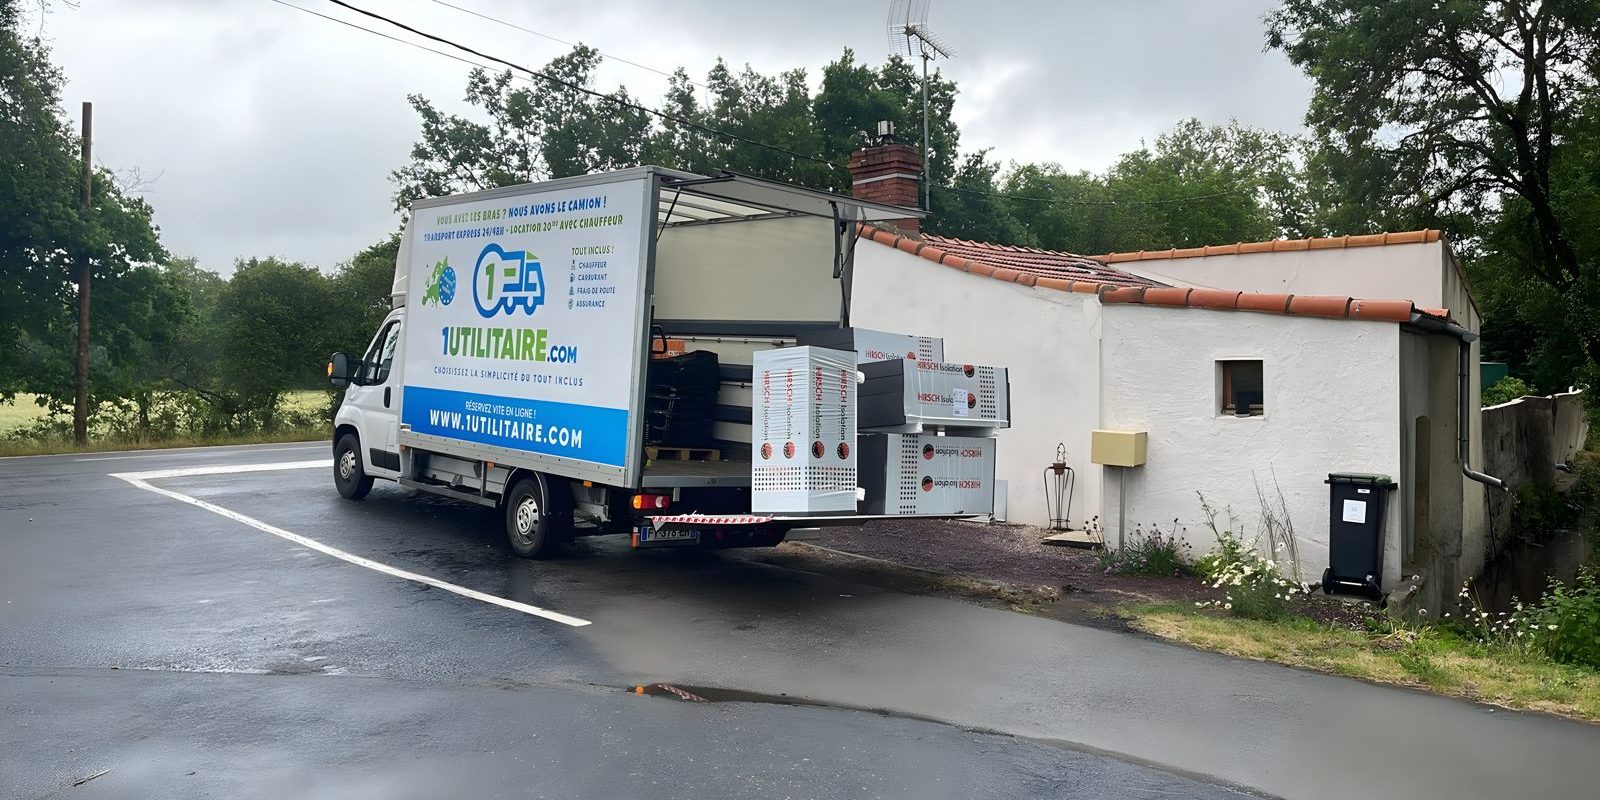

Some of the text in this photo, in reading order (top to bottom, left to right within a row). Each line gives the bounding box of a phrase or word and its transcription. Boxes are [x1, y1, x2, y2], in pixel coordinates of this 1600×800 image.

[436, 215, 452, 226] VOUS
[453, 212, 468, 224] AVEZ
[470, 211, 481, 221] LES
[482, 208, 500, 221] BRAS
[508, 205, 528, 218] NOUS
[529, 202, 555, 216] AVONS
[557, 200, 567, 212] LE
[568, 197, 601, 212] CAMION
[424, 231, 455, 242] TRANSPORT
[510, 222, 541, 235] LOCATION
[571, 247, 588, 256] TOUT
[588, 245, 611, 255] INCLUS
[579, 261, 607, 269] CHAUFFEUR
[591, 287, 598, 295] DE
[575, 300, 605, 308] ASSURANCE
[917, 361, 939, 371] HIRSCH
[939, 363, 963, 373] Isolation
[434, 366, 468, 377] CHOISISSEZ
[480, 369, 518, 382] SIMPLICITÉ
[521, 374, 530, 382] DU
[533, 374, 552, 385] TOUT
[554, 377, 584, 387] INCLUS
[815, 367, 823, 439] HIRSCH Isolation
[917, 393, 940, 402] HIRSCH
[465, 399, 492, 414] RÉSERVEZ
[492, 405, 506, 416] VITE
[505, 406, 514, 416] EN
[514, 406, 533, 419] LIGNE
[840, 369, 849, 441] HIRSCH Isolation
[430, 409, 583, 449] WWW.1UTILITAIRE.COM
[935, 448, 982, 458] HIRSCH Isolation
[934, 480, 981, 490] HIRSCH Isolation
